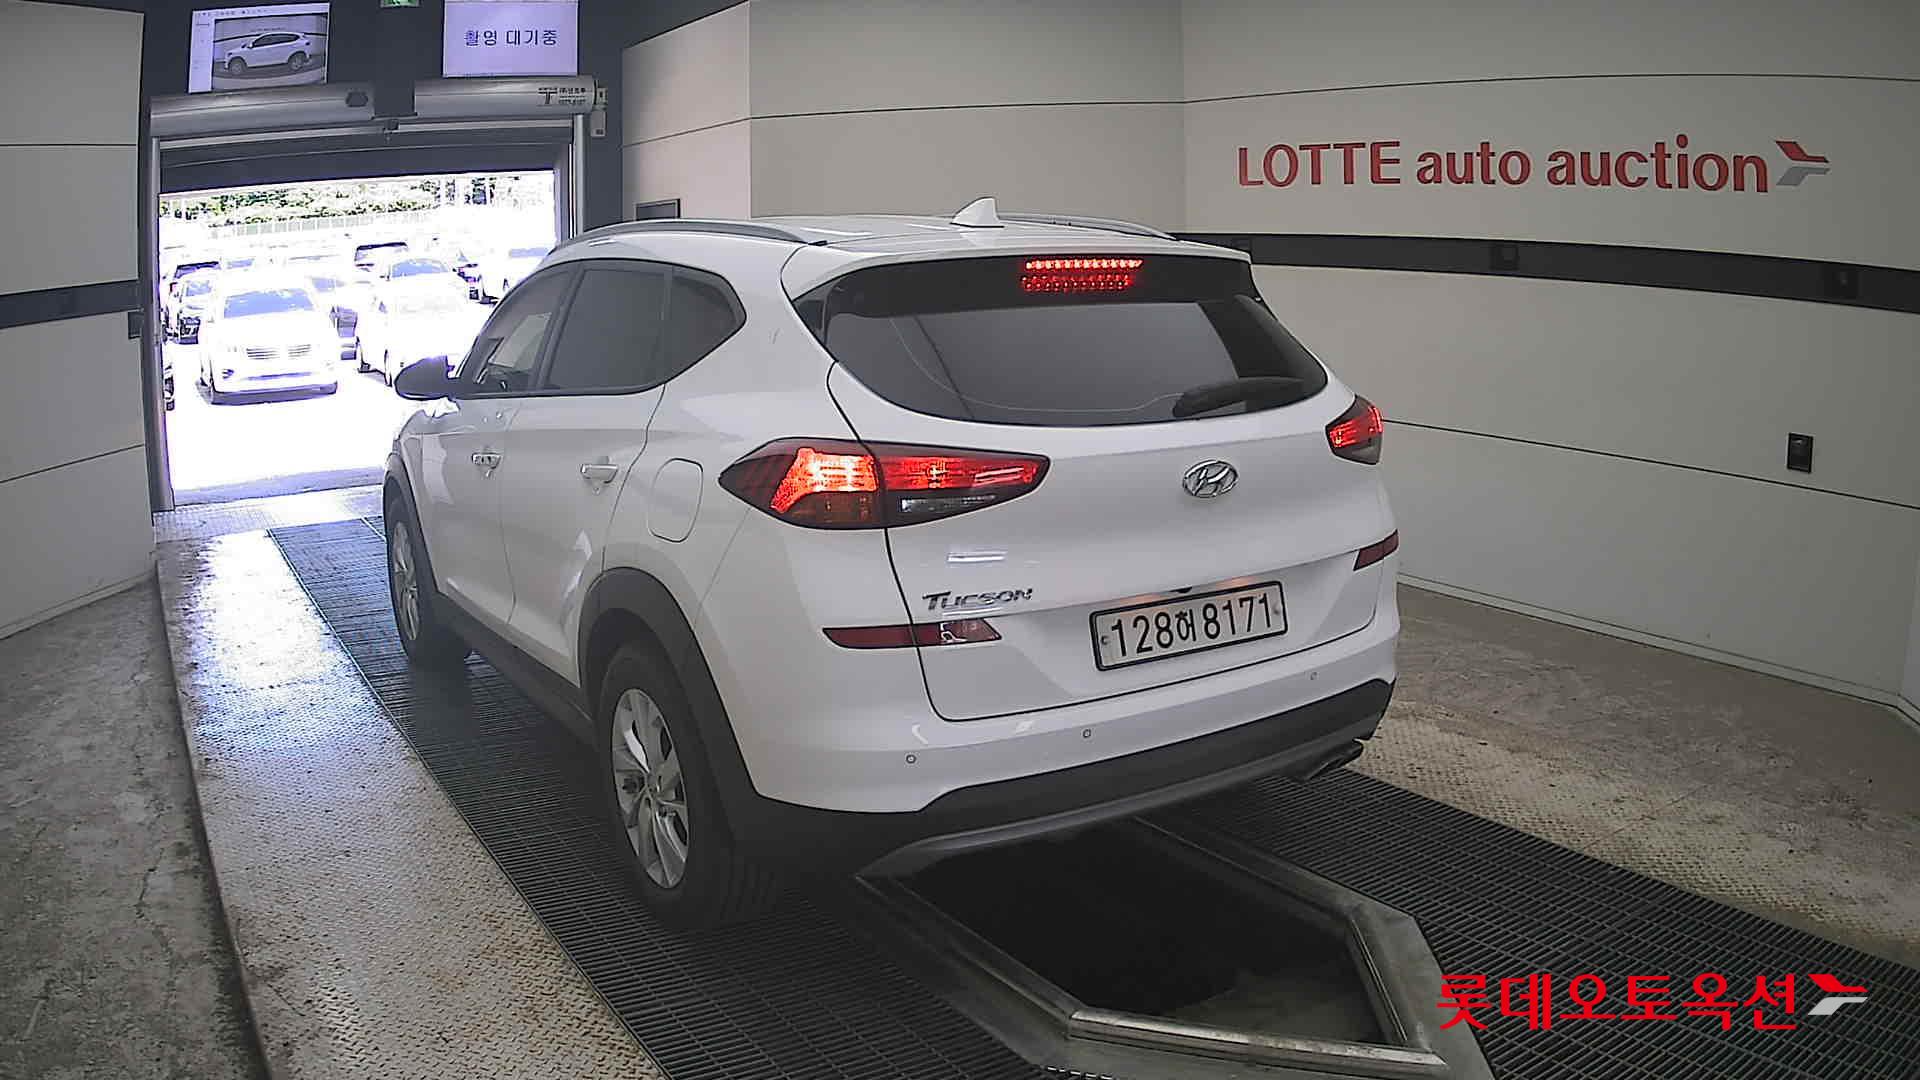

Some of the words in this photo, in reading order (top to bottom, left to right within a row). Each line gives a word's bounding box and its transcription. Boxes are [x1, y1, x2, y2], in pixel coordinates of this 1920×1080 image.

[464, 30, 497, 46] 촬영
[505, 29, 557, 46] 대기중
[1239, 141, 1400, 187] LOTTE
[1416, 140, 1531, 186] auto
[1547, 134, 1768, 193] auction
